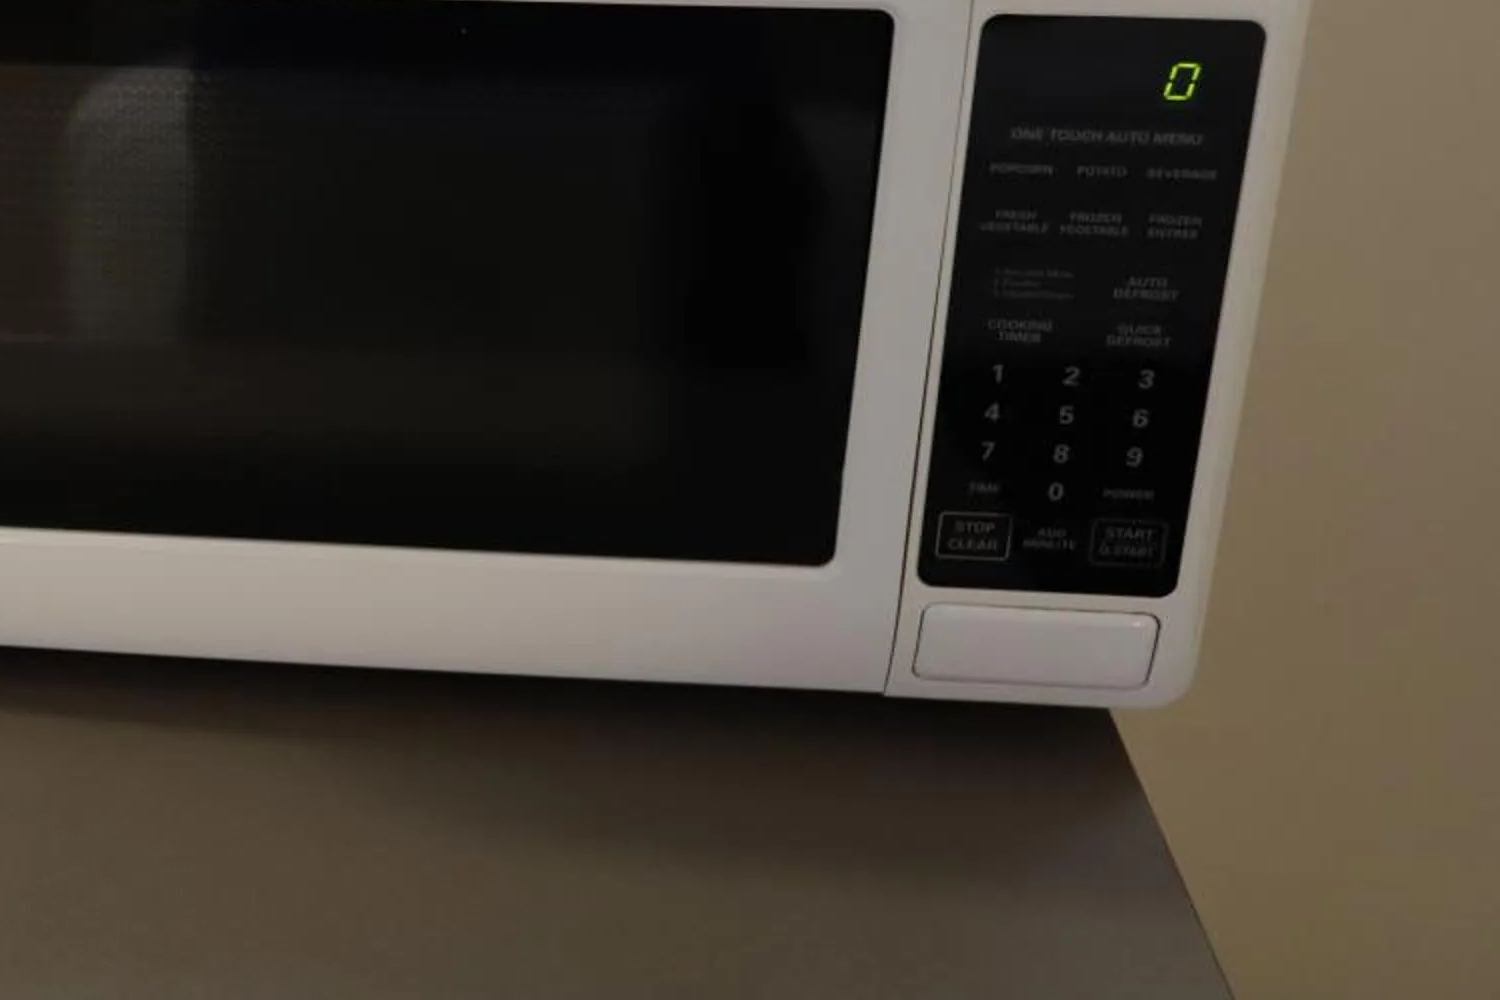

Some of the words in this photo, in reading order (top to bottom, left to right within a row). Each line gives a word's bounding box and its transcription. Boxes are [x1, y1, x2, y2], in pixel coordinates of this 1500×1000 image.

[1163, 63, 1201, 100] 0
[992, 364, 1004, 384] 1
[1062, 366, 1081, 387] 2
[1138, 369, 1156, 389] 3
[984, 402, 1001, 422] 4
[1059, 405, 1075, 424] 5
[1132, 408, 1150, 429] 6
[981, 441, 996, 462] 7
[1053, 444, 1070, 464] 8
[1125, 447, 1144, 468] 9
[1047, 482, 1065, 502] 0
[954, 521, 996, 533] STOP
[946, 538, 998, 551] CLEAR
